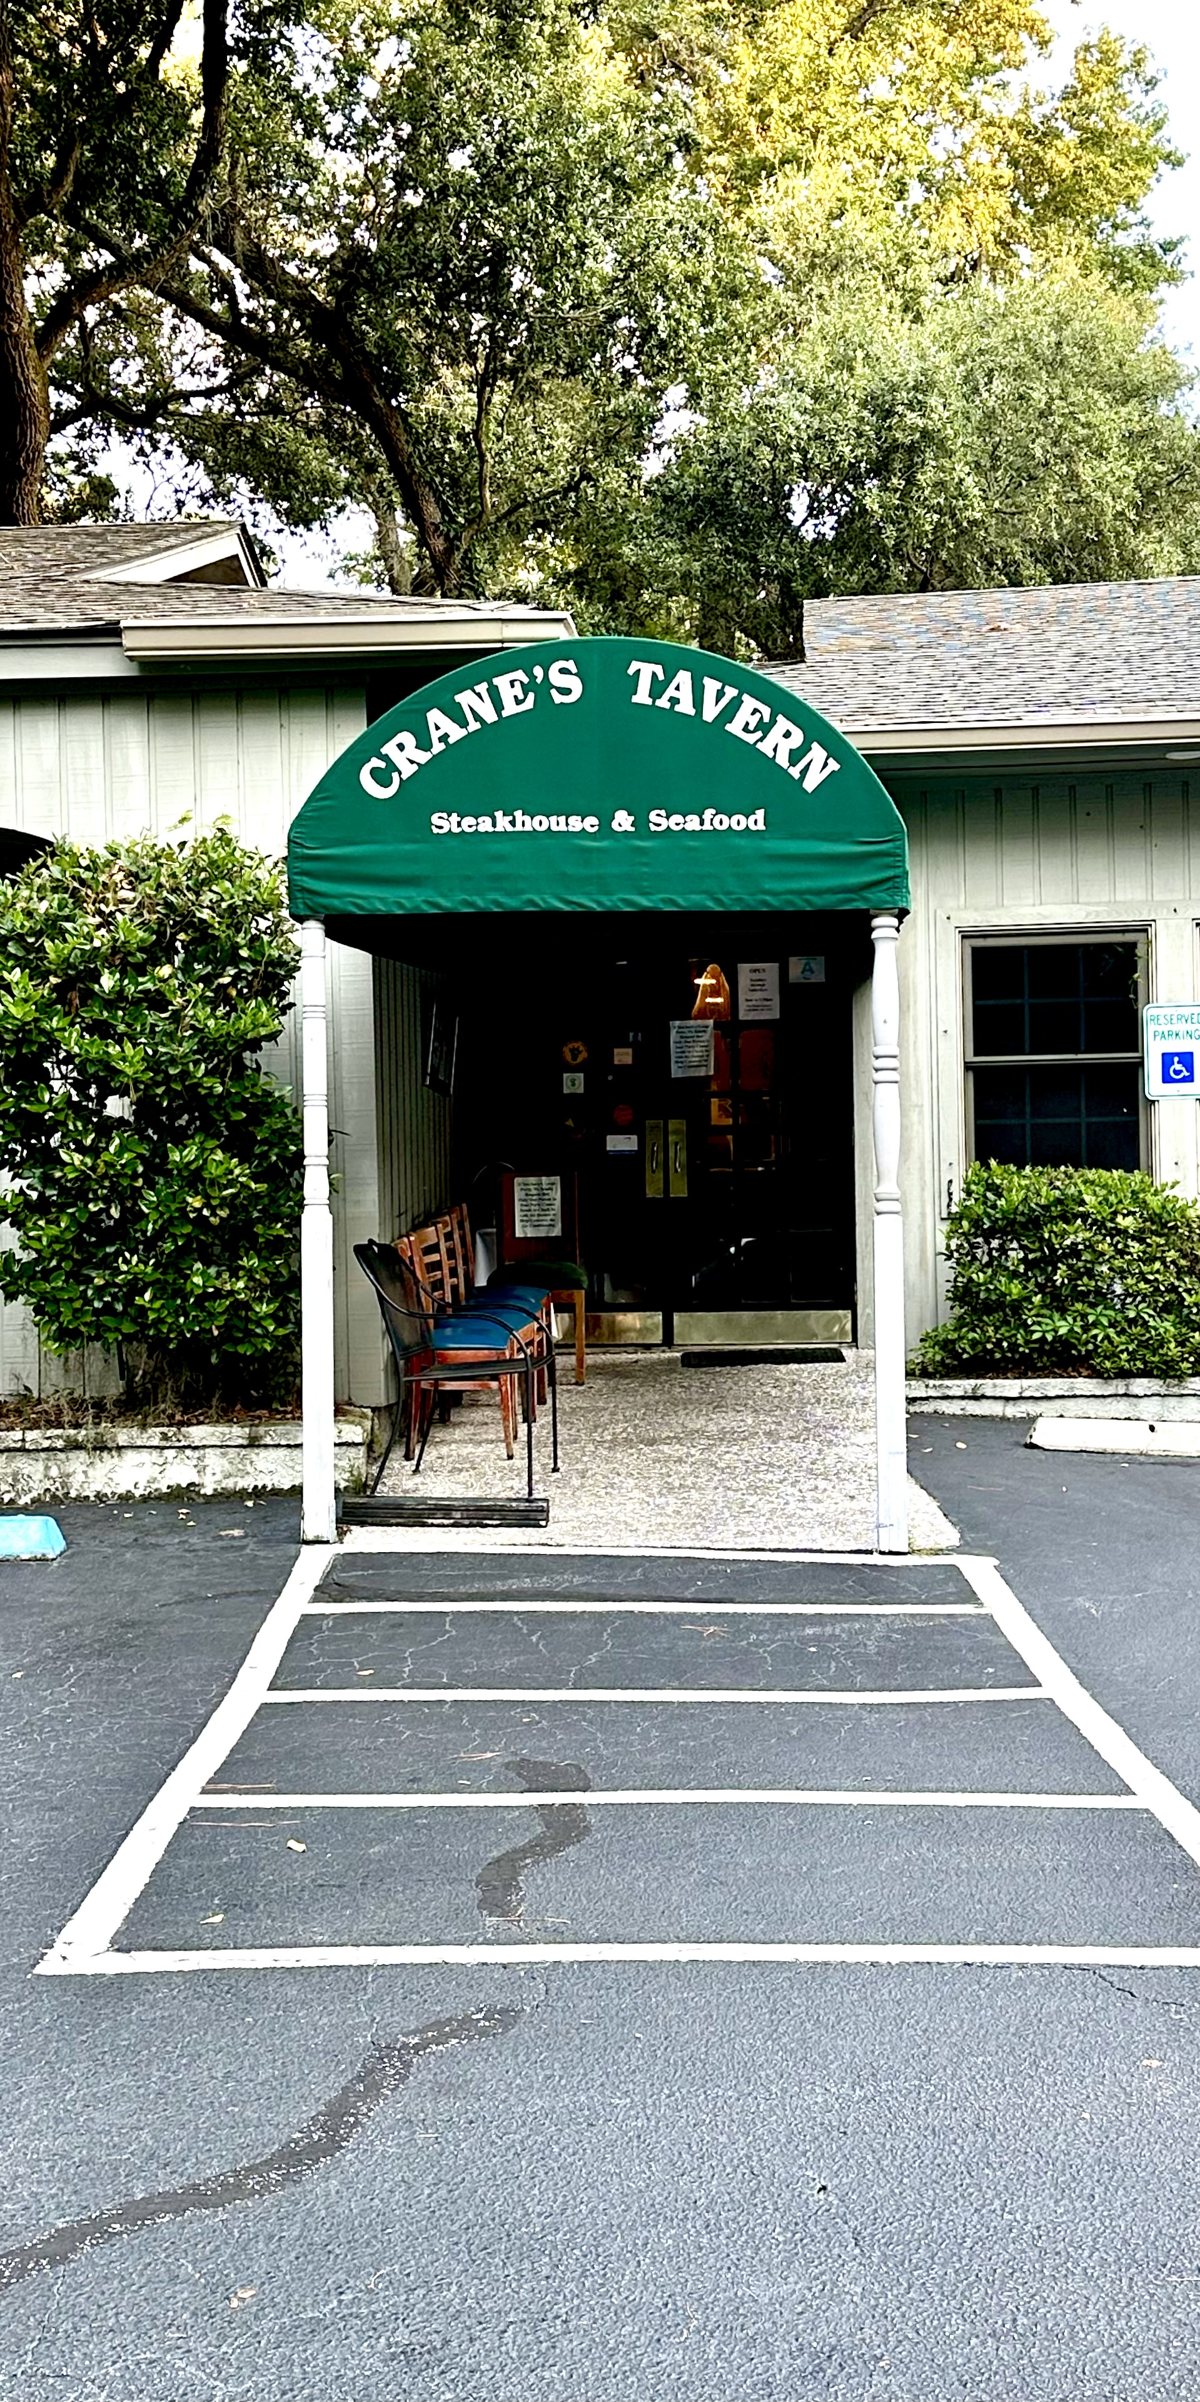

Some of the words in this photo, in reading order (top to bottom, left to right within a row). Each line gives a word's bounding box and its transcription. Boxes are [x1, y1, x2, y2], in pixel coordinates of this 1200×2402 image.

[360, 660, 583, 800] CRANE'S
[627, 661, 840, 794] TAVERN
[430, 809, 600, 834] Steakhouse
[611, 809, 636, 832] &
[649, 808, 766, 832] Seafood
[1153, 1029, 1200, 1041] PARKING
